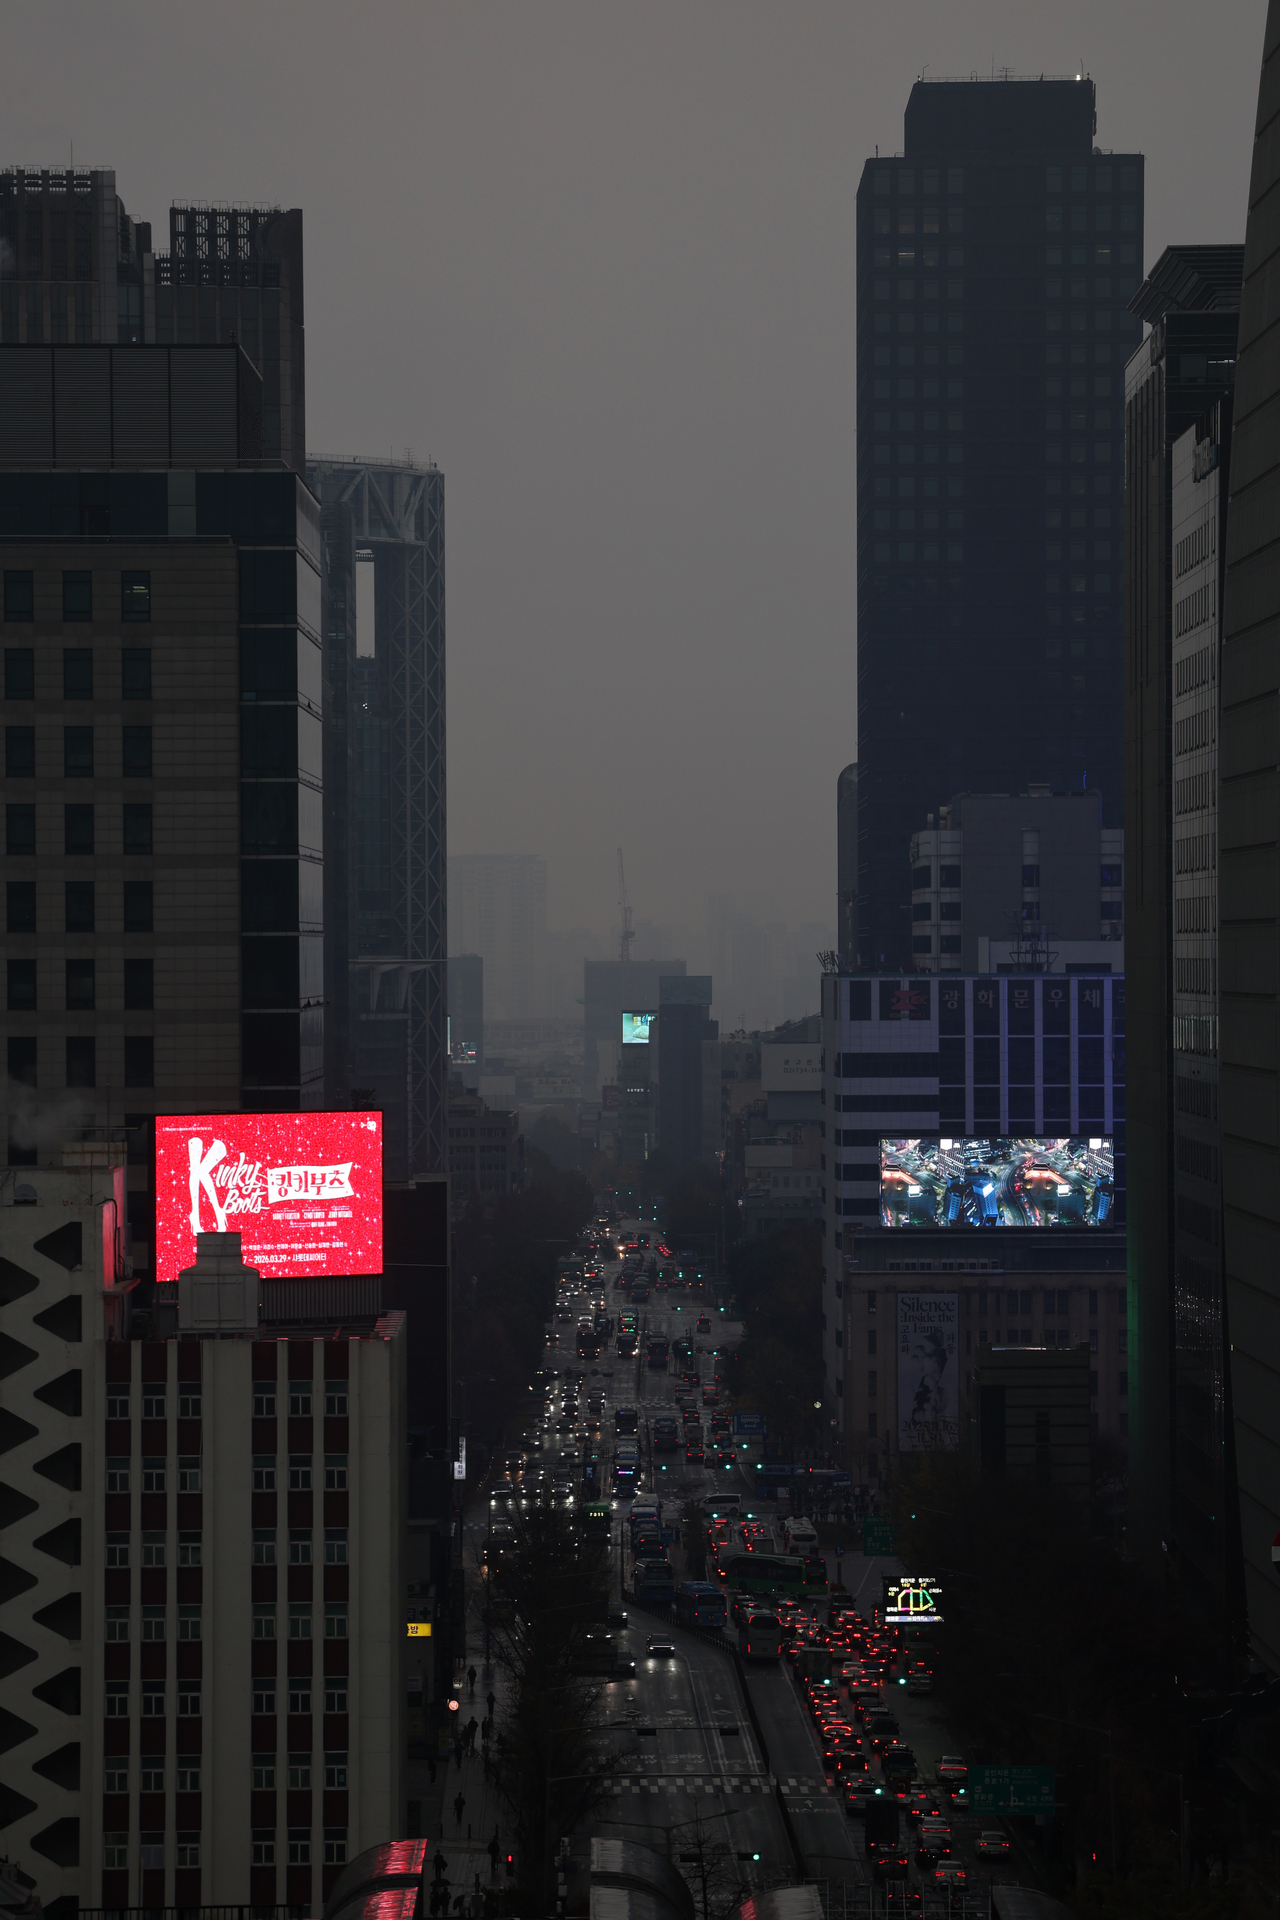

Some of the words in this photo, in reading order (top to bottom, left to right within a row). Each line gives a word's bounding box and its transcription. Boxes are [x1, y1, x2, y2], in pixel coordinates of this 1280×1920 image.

[187, 1136, 269, 1236] Kinky
[275, 1169, 346, 1198] 킹키부츠
[222, 1188, 270, 1214] Boots
[900, 1296, 955, 1312] Silence
[938, 1312, 955, 1323] the
[900, 1325, 911, 1355] 고요와
[973, 1793, 994, 1801] 광화문
